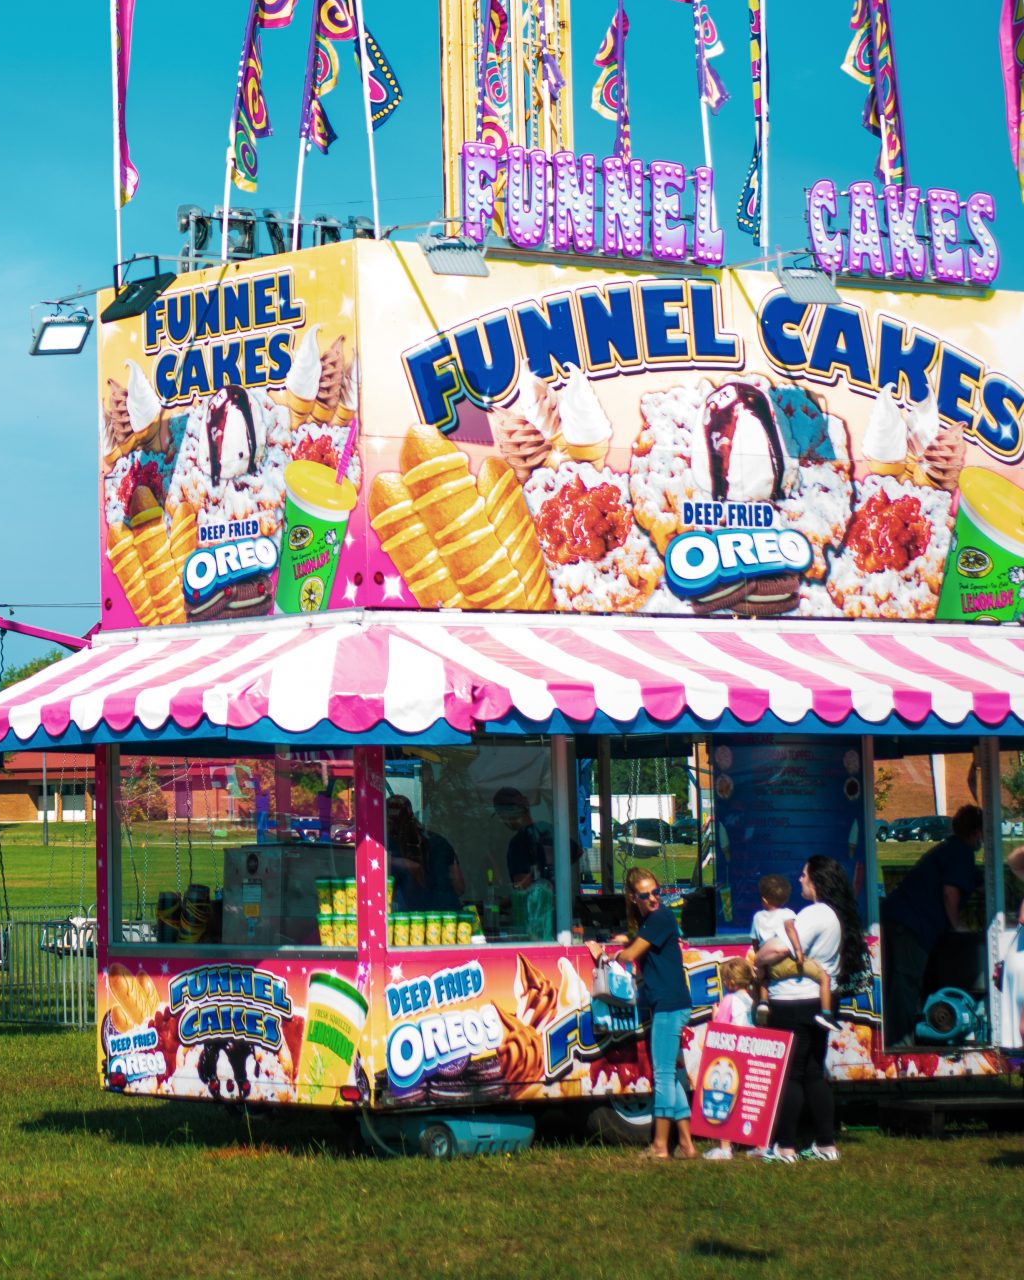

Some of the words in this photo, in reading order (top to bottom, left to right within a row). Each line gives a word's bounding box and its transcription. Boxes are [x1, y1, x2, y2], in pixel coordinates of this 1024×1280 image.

[462, 141, 724, 265] FUNNEL
[808, 179, 1000, 285] CAKES
[145, 270, 304, 351] FUNNEL
[155, 329, 295, 404] CAKES
[402, 279, 743, 429] FUNNEL
[757, 288, 1024, 458] CAKES
[199, 524, 226, 542] DEEP
[228, 520, 259, 538] FRIED
[682, 502, 724, 526] DEEP
[727, 503, 774, 527] FRIED
[185, 537, 278, 590] OREO
[669, 530, 812, 581] OREO
[961, 589, 1014, 613] LEMONADE
[170, 967, 291, 1014] FUNNEL
[387, 979, 432, 1017] DEEP
[433, 968, 483, 1003] FRIED
[110, 1034, 131, 1052] DEEP
[132, 1030, 158, 1048] FRIED
[180, 1004, 281, 1046] CAKES
[307, 1019, 355, 1067] LEMONADE
[389, 1005, 502, 1078] OREOS
[706, 1030, 737, 1052] MASKS
[736, 1034, 786, 1060] REQUIRED
[109, 1052, 166, 1078] OREOS
